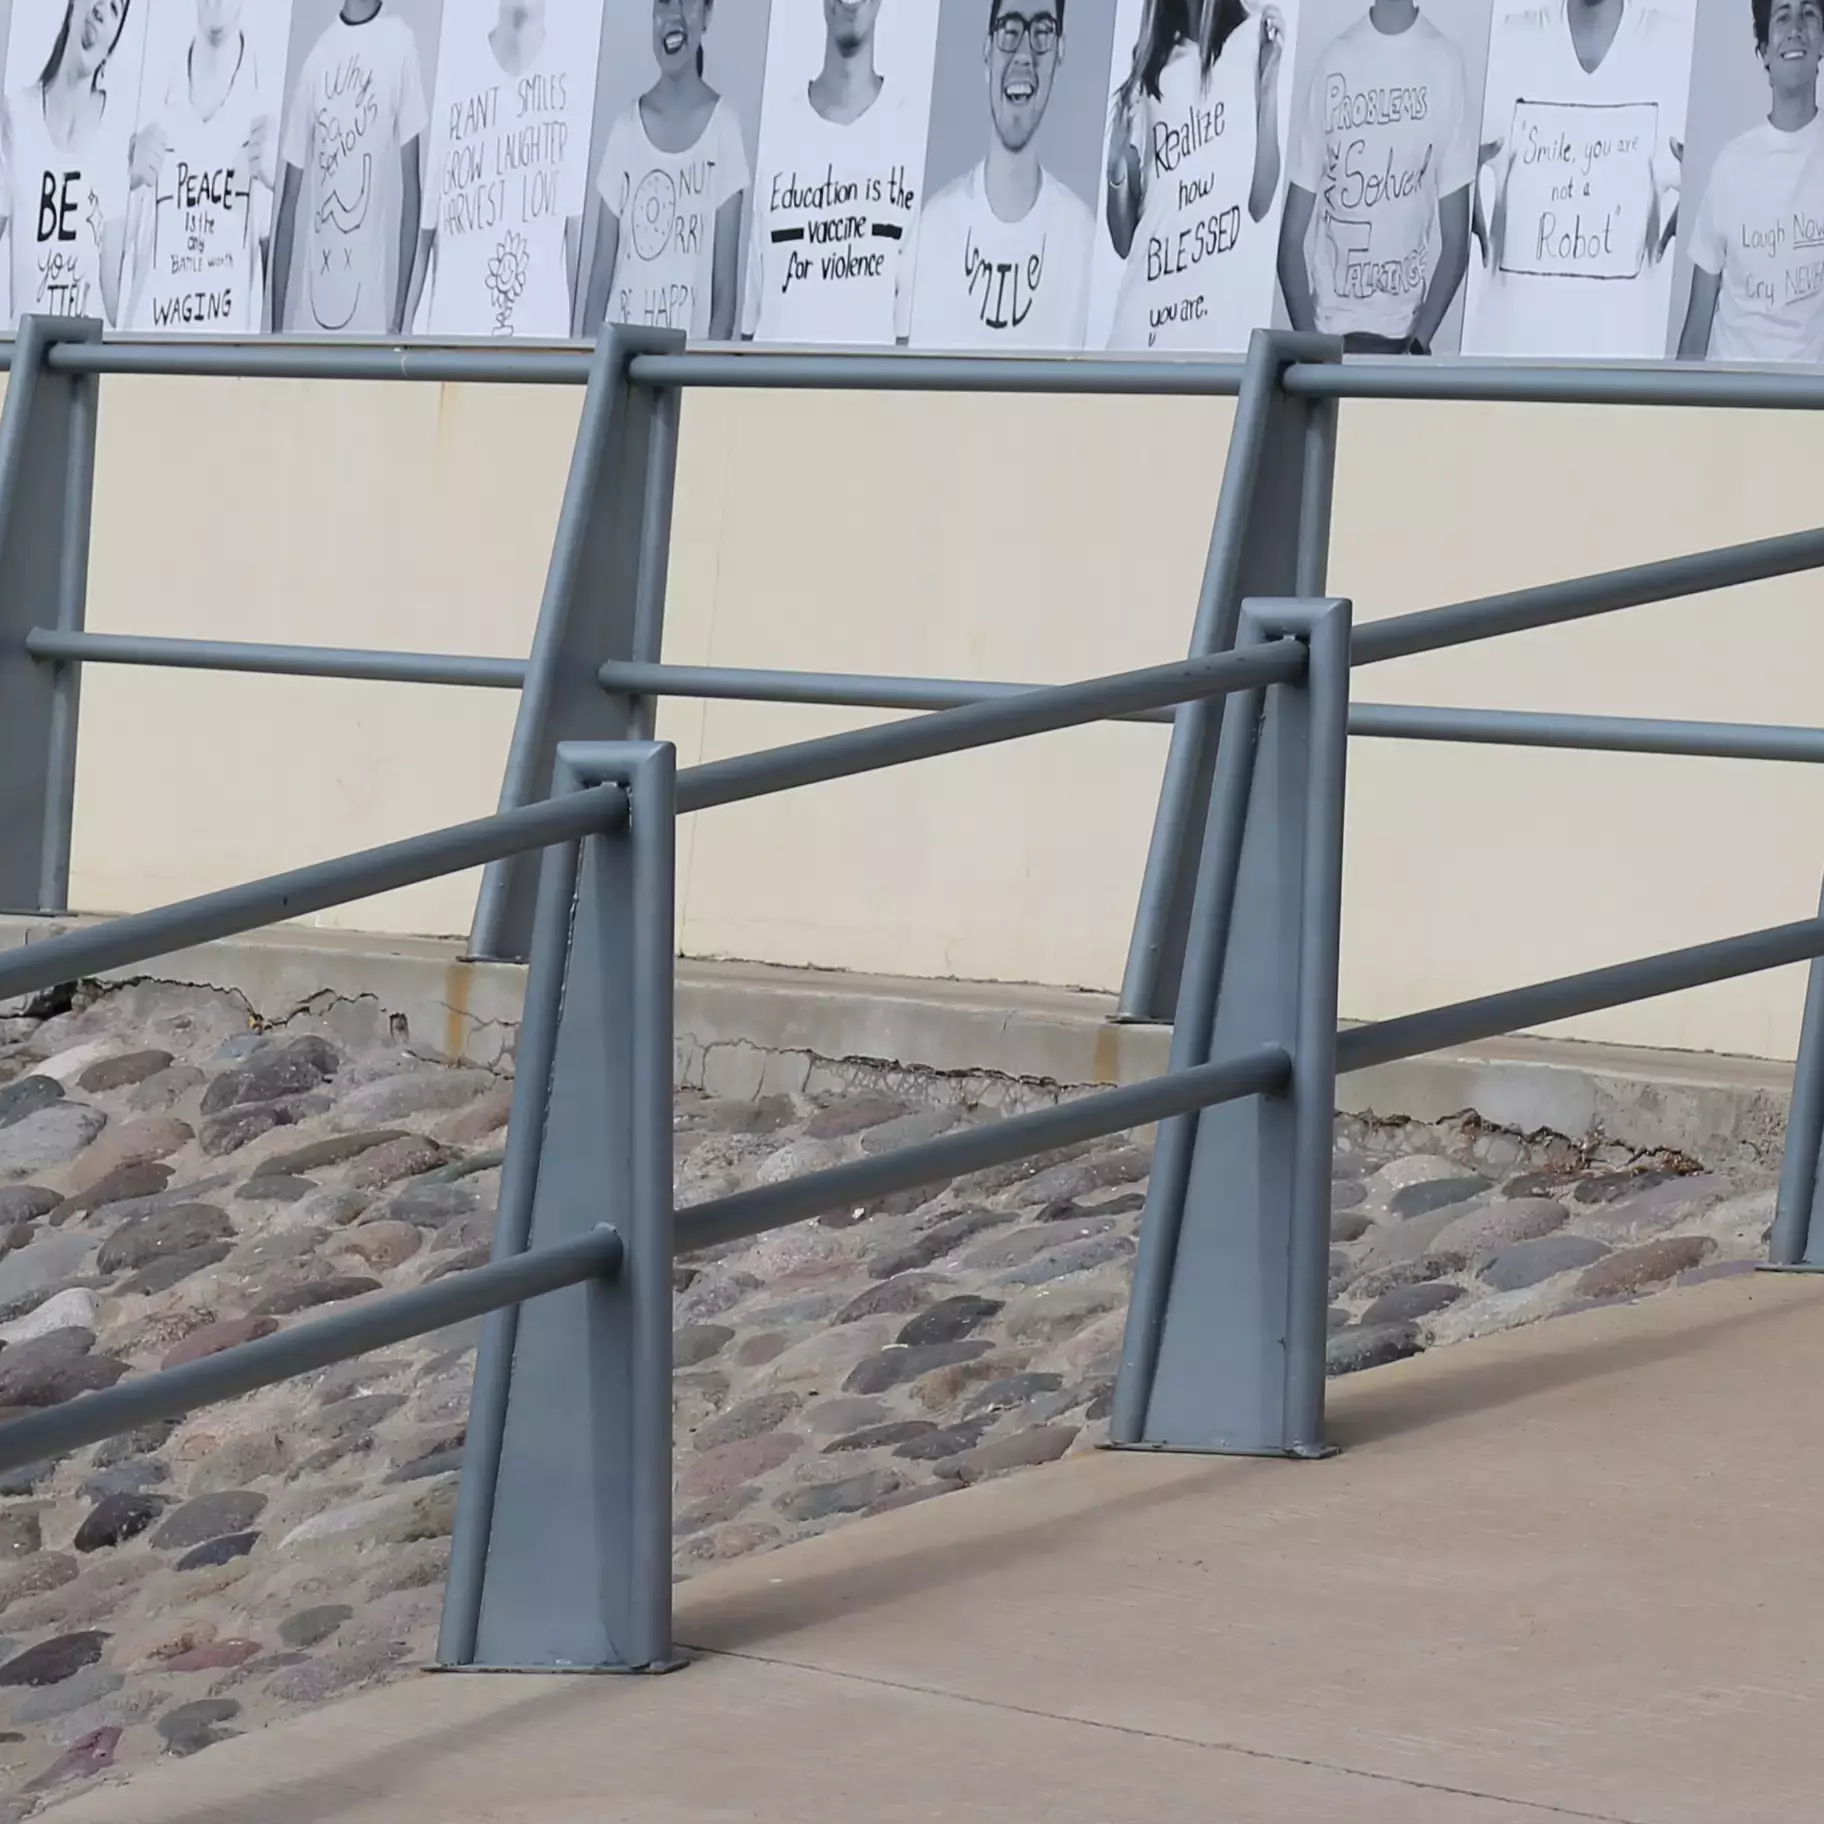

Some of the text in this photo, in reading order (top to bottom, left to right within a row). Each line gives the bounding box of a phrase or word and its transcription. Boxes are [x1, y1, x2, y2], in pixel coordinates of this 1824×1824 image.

[324, 52, 373, 106] Why
[1325, 72, 1428, 135] PROBLEMS
[449, 72, 567, 140] PLANT SMILES
[443, 121, 568, 196] GROW LAUGHTER
[1152, 101, 1226, 179] Realize
[1581, 139, 1612, 176] you
[177, 161, 235, 210] PEACE
[770, 163, 914, 213] Education is the
[1179, 171, 1215, 210] how
[1341, 139, 1433, 209] Solved
[1551, 180, 1591, 202] not a
[37, 170, 81, 243] BE
[443, 179, 506, 236] HARVEST
[807, 215, 867, 244] vaccine
[1147, 205, 1241, 282] BLESSED
[1741, 219, 1786, 258] Laugh
[37, 248, 84, 303] you
[782, 243, 885, 294] for violence
[1745, 273, 1774, 310] Cry
[153, 289, 231, 326] WAGING
[1180, 295, 1209, 321] are.
